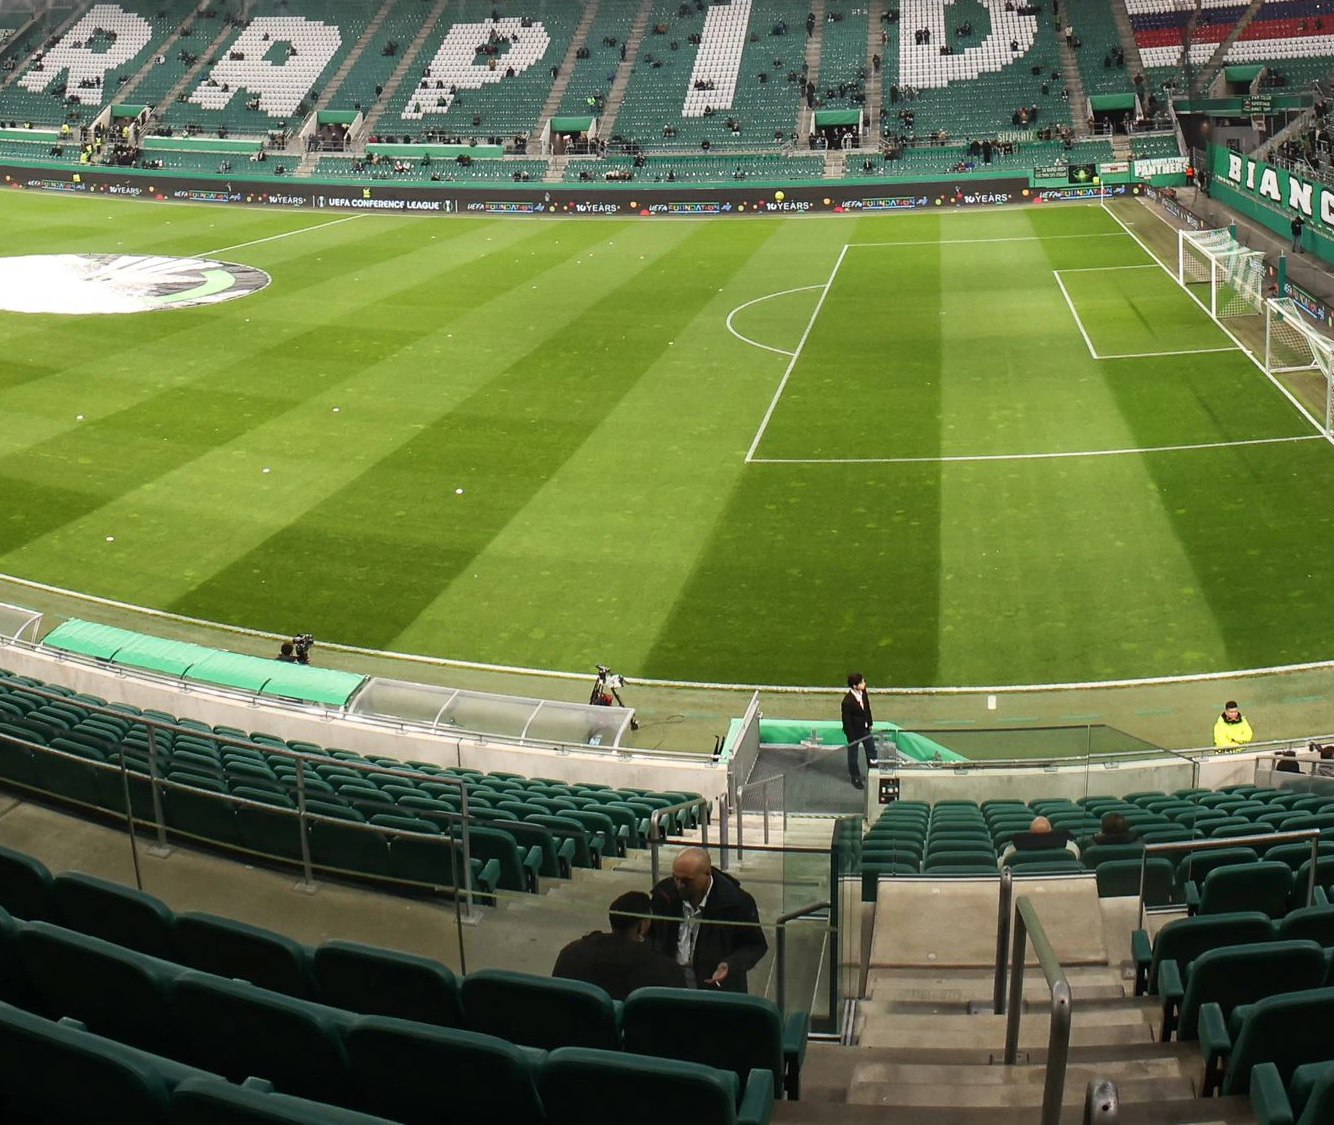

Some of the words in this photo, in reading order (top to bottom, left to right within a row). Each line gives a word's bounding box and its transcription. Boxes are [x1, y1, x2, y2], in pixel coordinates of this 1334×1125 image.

[329, 197, 350, 207] UEFA
[351, 198, 405, 209] CONFERENCE
[407, 200, 440, 210] LEAGUE
